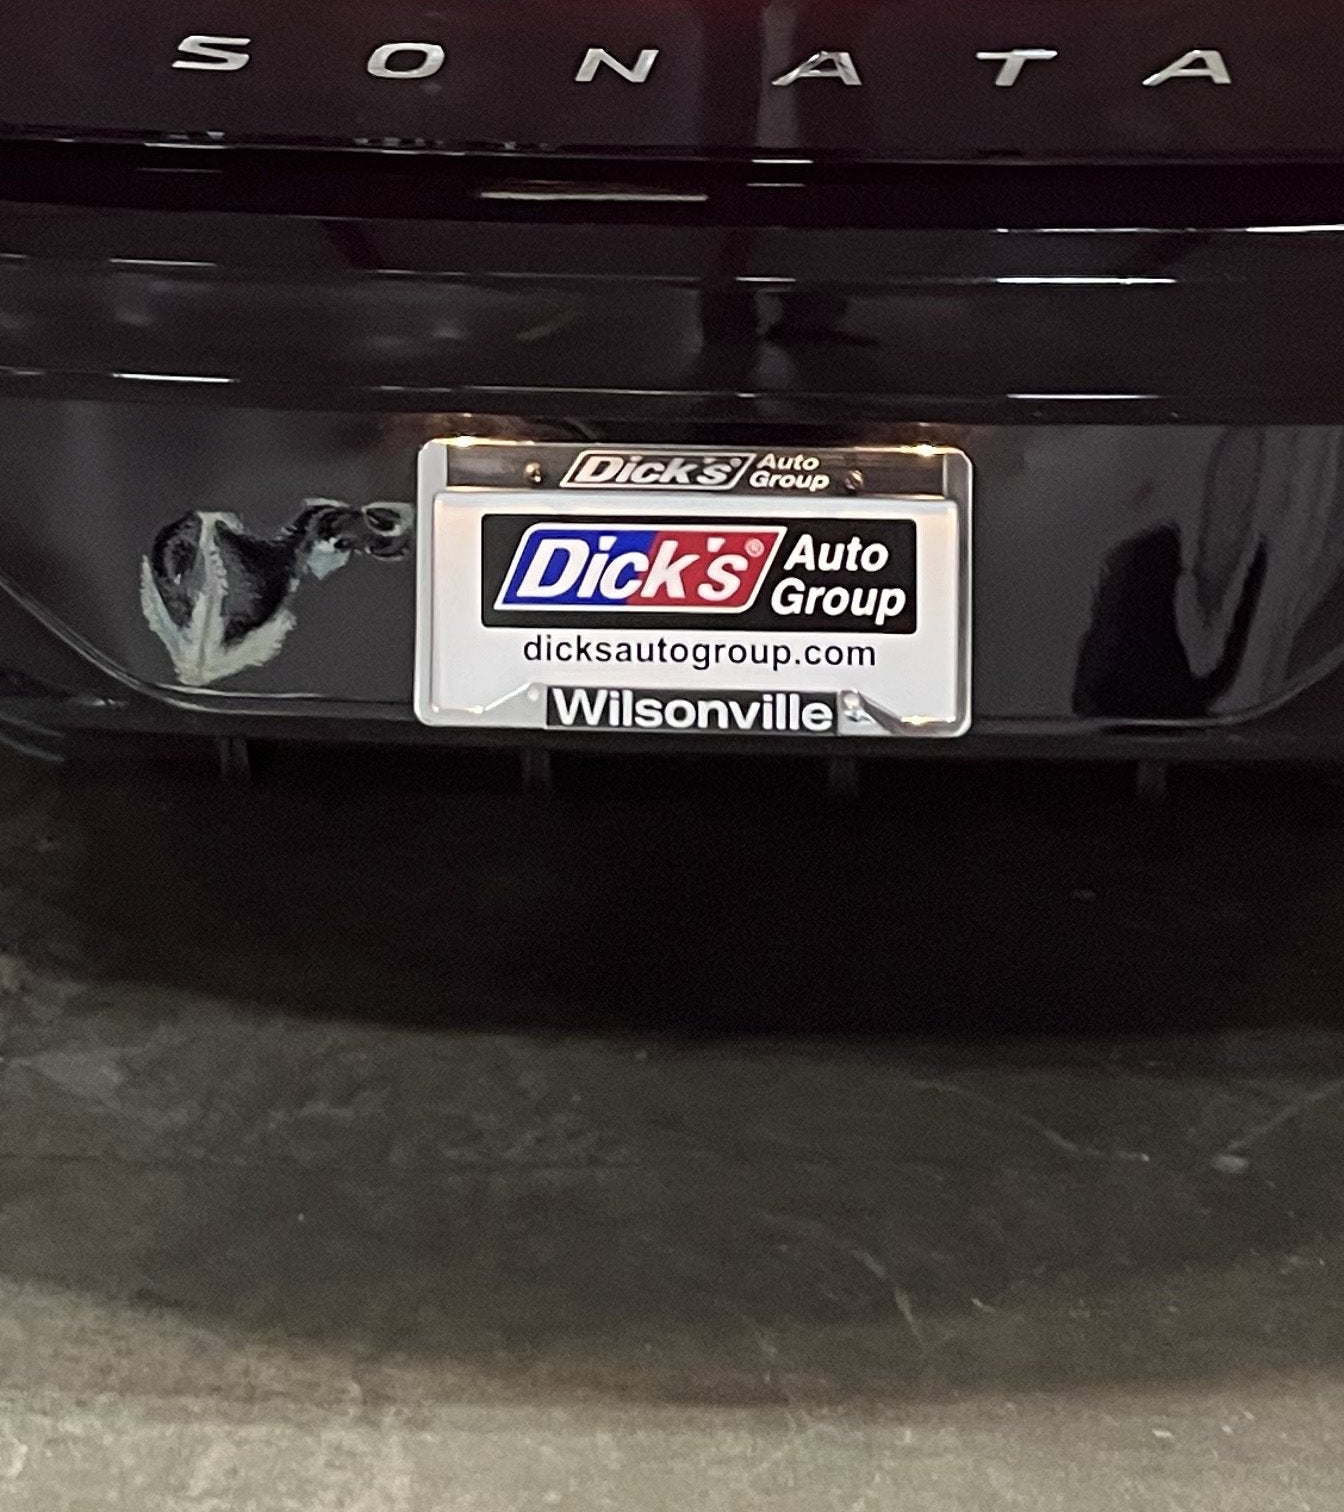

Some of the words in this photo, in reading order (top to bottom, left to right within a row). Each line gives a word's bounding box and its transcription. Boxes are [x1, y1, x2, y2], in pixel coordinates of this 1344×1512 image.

[172, 34, 1233, 87] SONATA
[574, 455, 732, 485] Dick's
[749, 470, 830, 491] Group
[757, 453, 820, 471] Auto
[516, 536, 749, 601] Dick's
[784, 534, 888, 572] Auto
[771, 577, 906, 625] Group
[523, 634, 876, 671] dicksautogroup.com
[552, 689, 833, 732] Wilsonville
